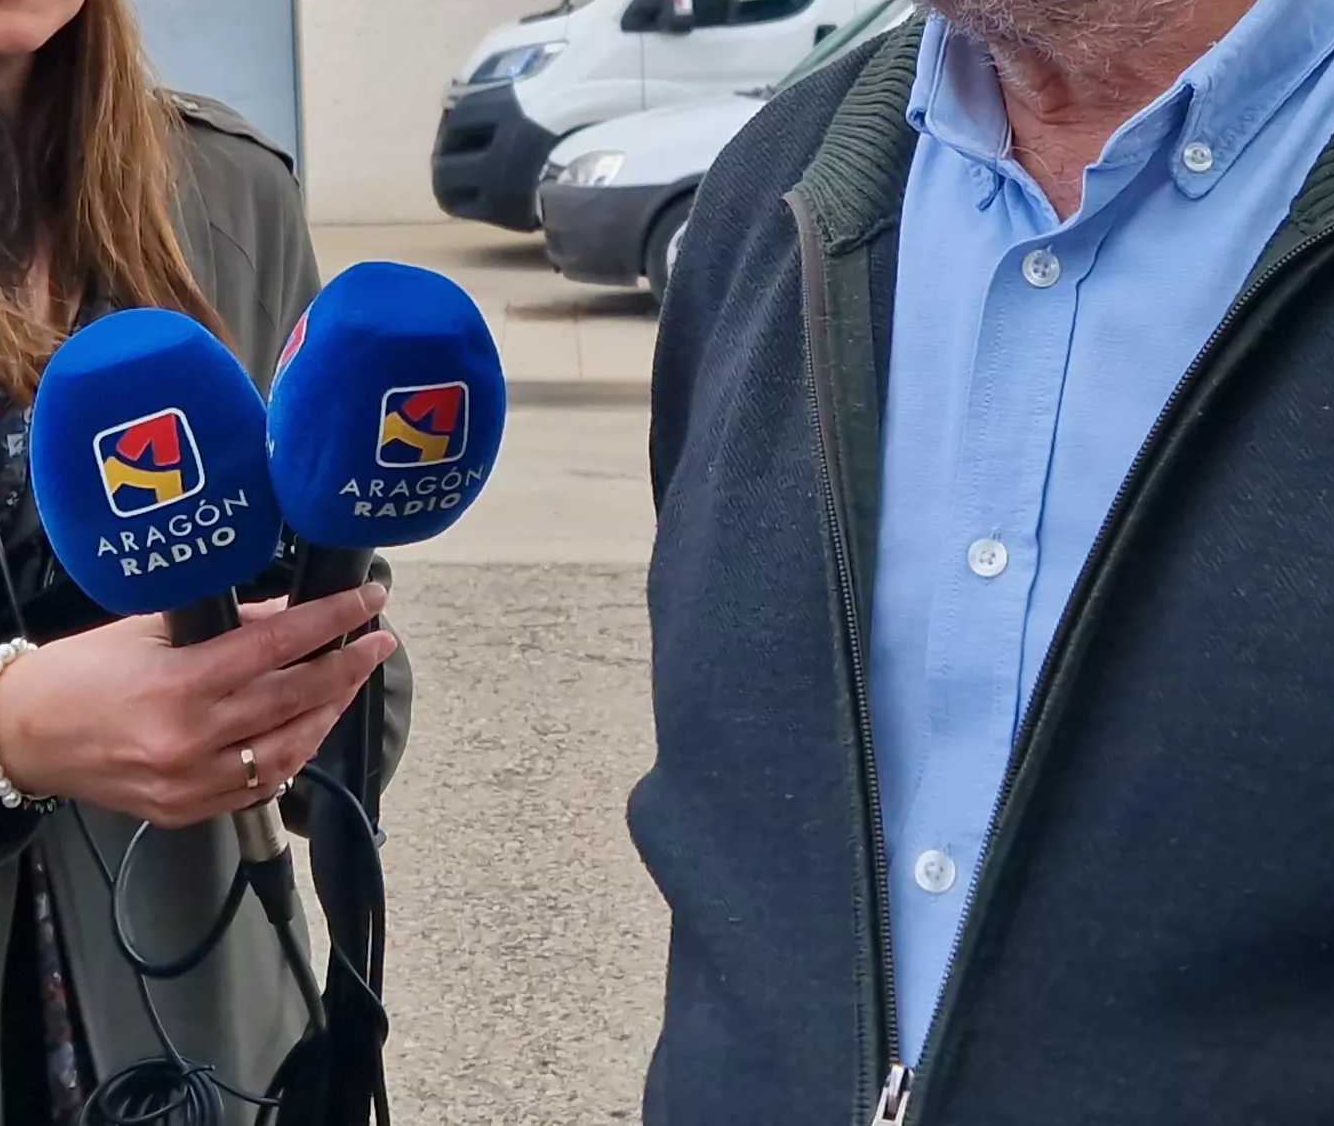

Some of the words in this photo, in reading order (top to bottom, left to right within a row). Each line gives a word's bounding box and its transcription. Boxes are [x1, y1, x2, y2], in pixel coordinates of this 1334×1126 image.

[339, 464, 484, 498] ARAGÓN
[97, 489, 249, 558] ARAGÓN
[354, 492, 461, 518] RADIO
[120, 526, 236, 577] RADIO
